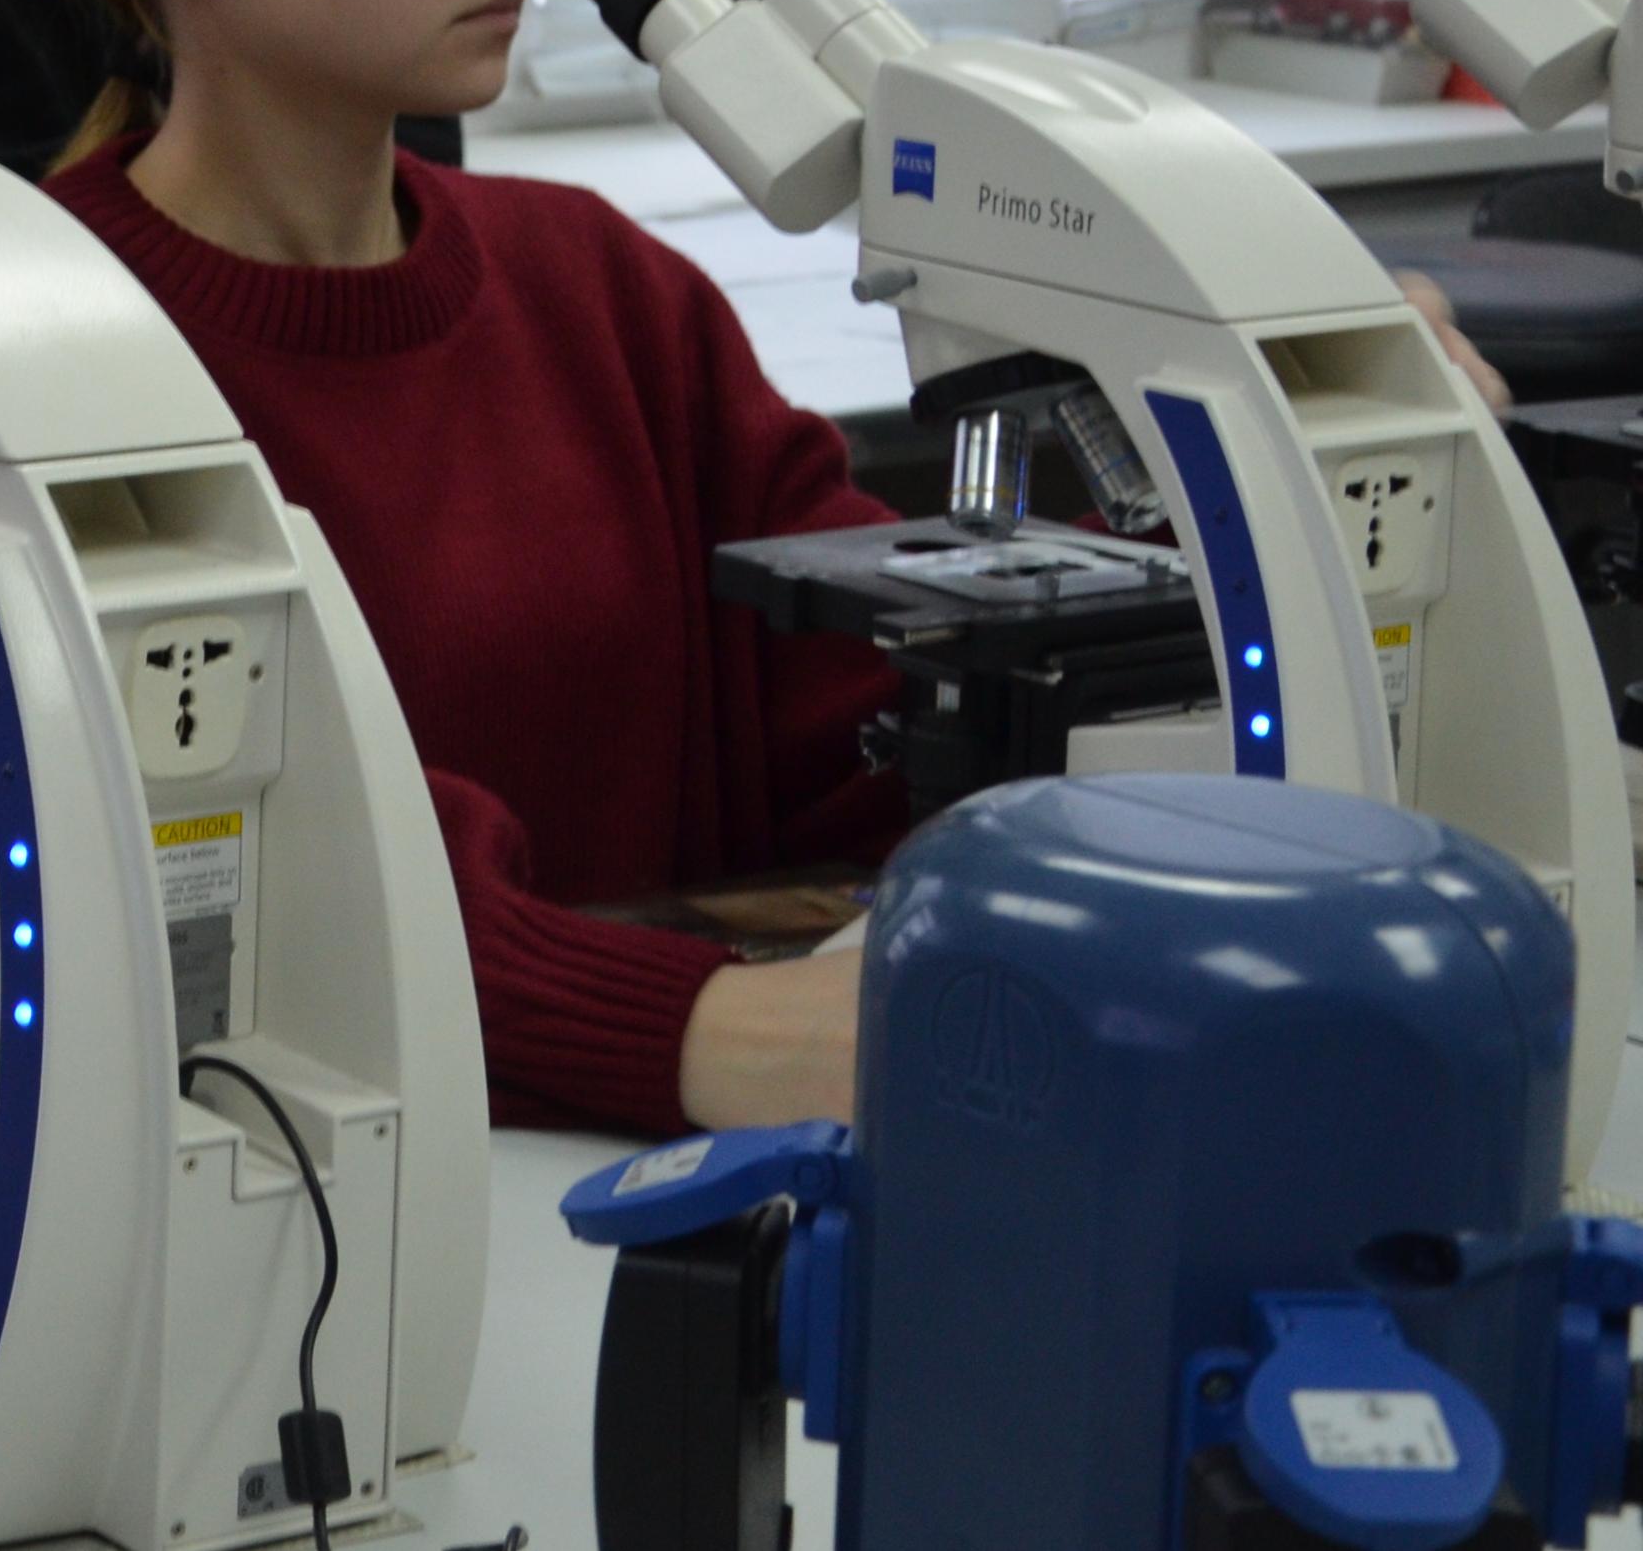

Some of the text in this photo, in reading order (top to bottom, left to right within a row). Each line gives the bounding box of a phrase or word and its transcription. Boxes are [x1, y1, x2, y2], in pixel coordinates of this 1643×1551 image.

[978, 183, 1096, 236] Primo Star
[157, 815, 231, 845] CAUTION
